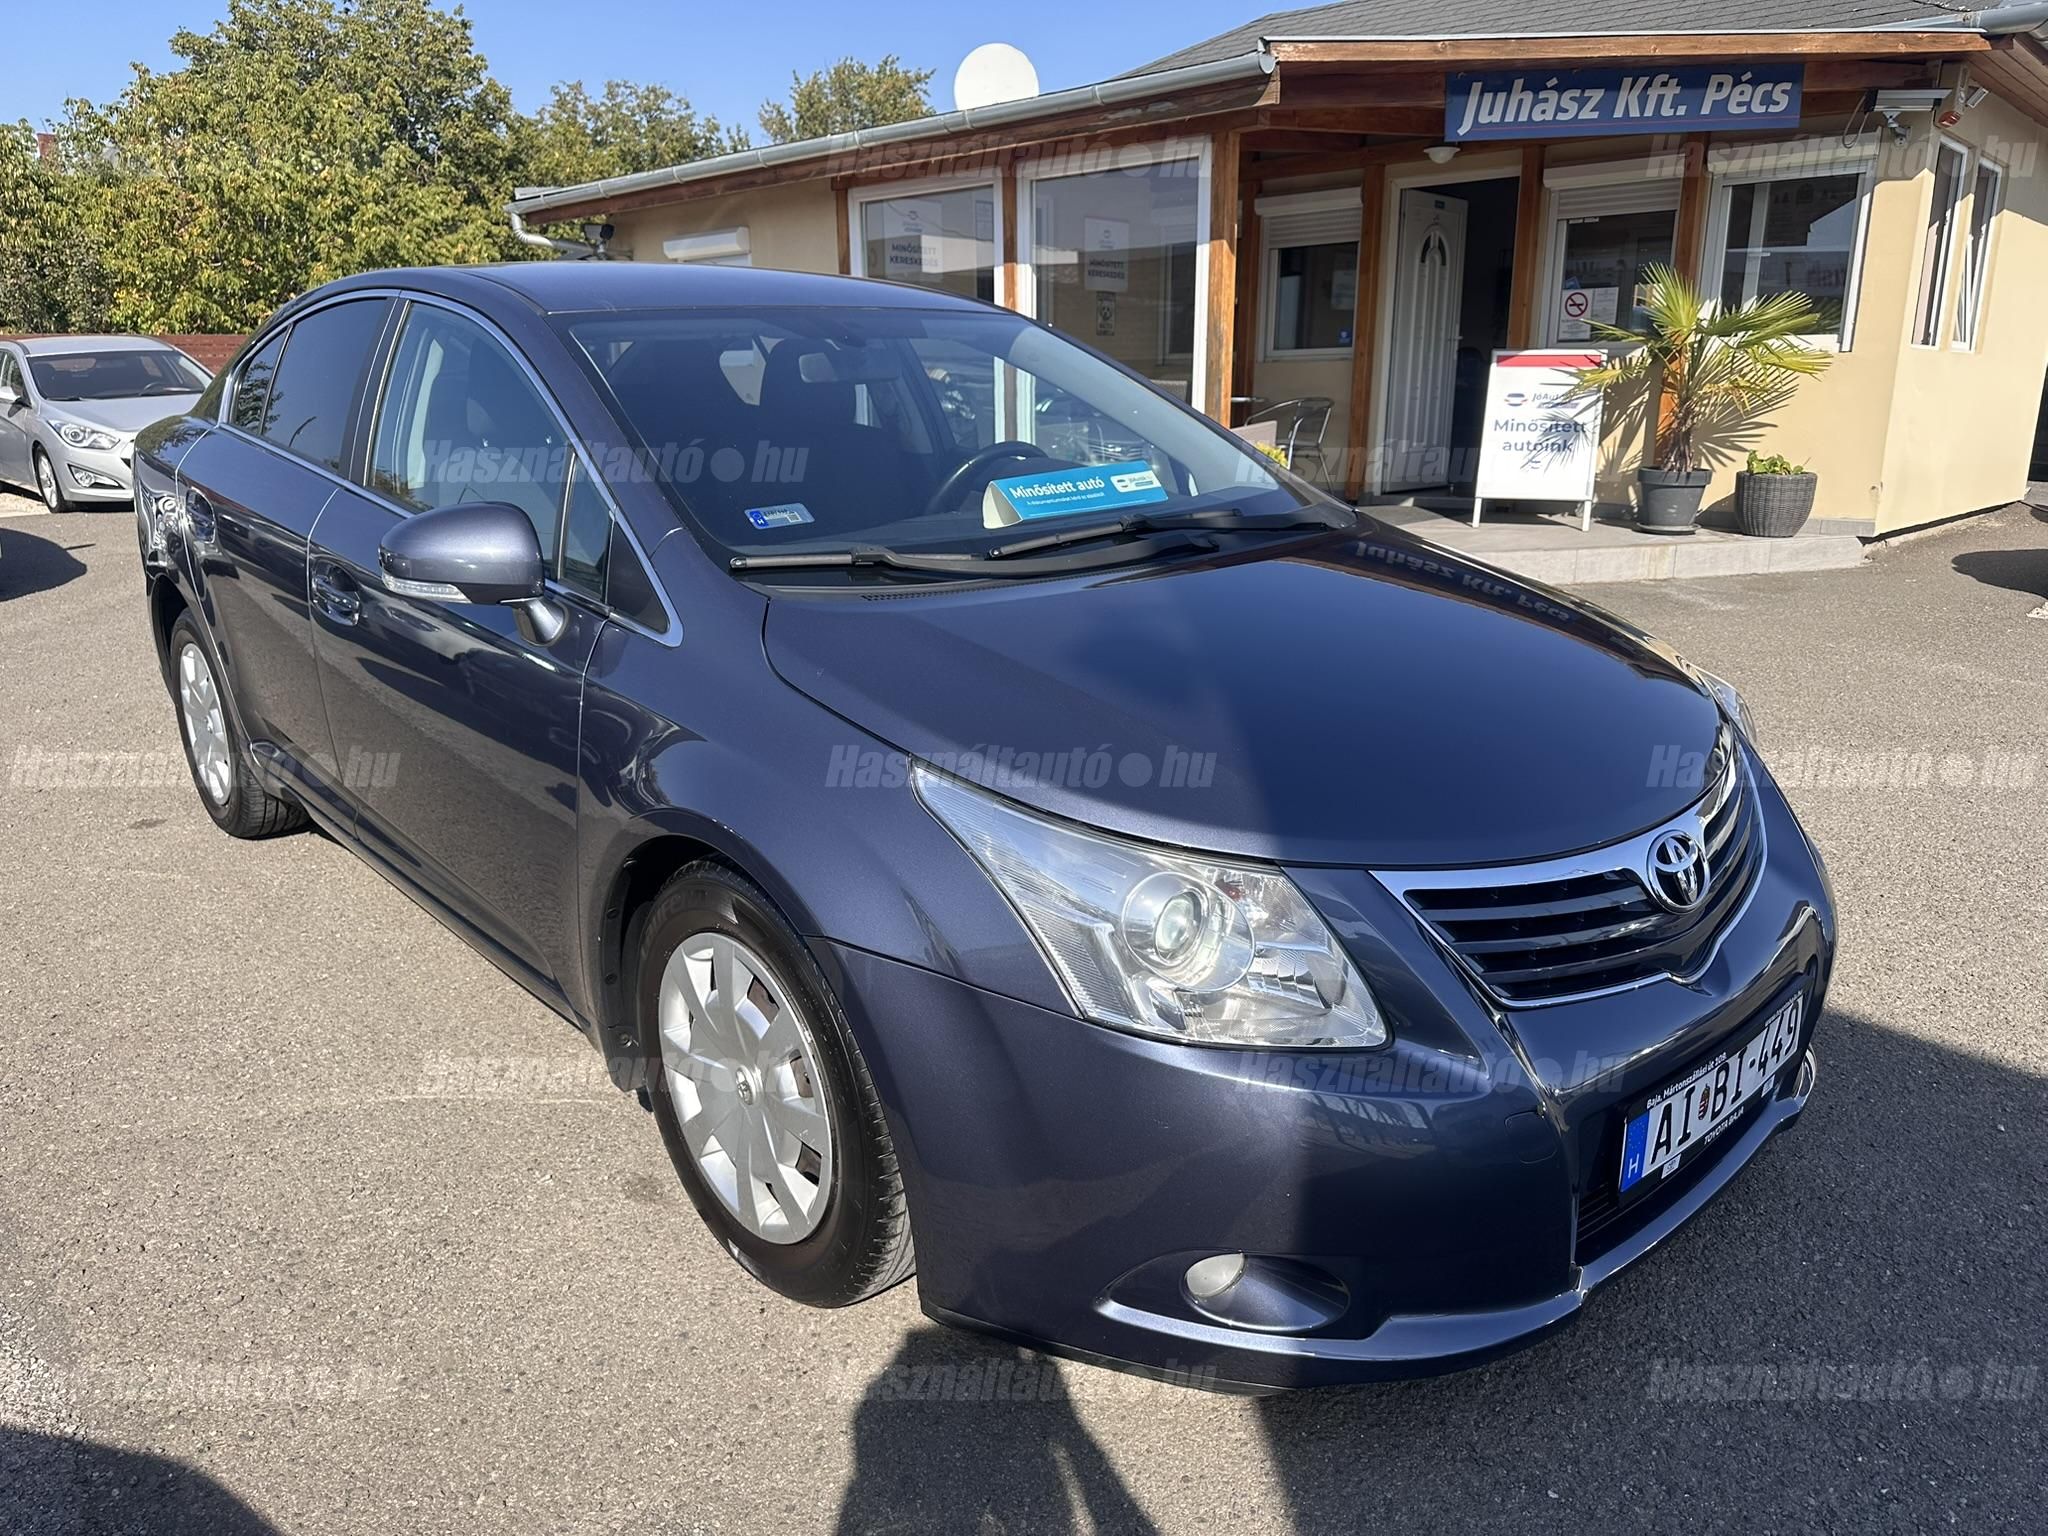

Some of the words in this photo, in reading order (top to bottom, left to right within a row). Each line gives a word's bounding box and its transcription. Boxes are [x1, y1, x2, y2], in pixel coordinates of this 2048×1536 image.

[1457, 77, 1605, 136] Juhász
[1612, 73, 1687, 119] Kft.
[1700, 71, 1793, 116] Pécs
[1009, 480, 1077, 499] Minősített
[1076, 476, 1105, 491] autó
[1704, 1119, 1729, 1145] TOYOTA
[1627, 1153, 1640, 1179] H
